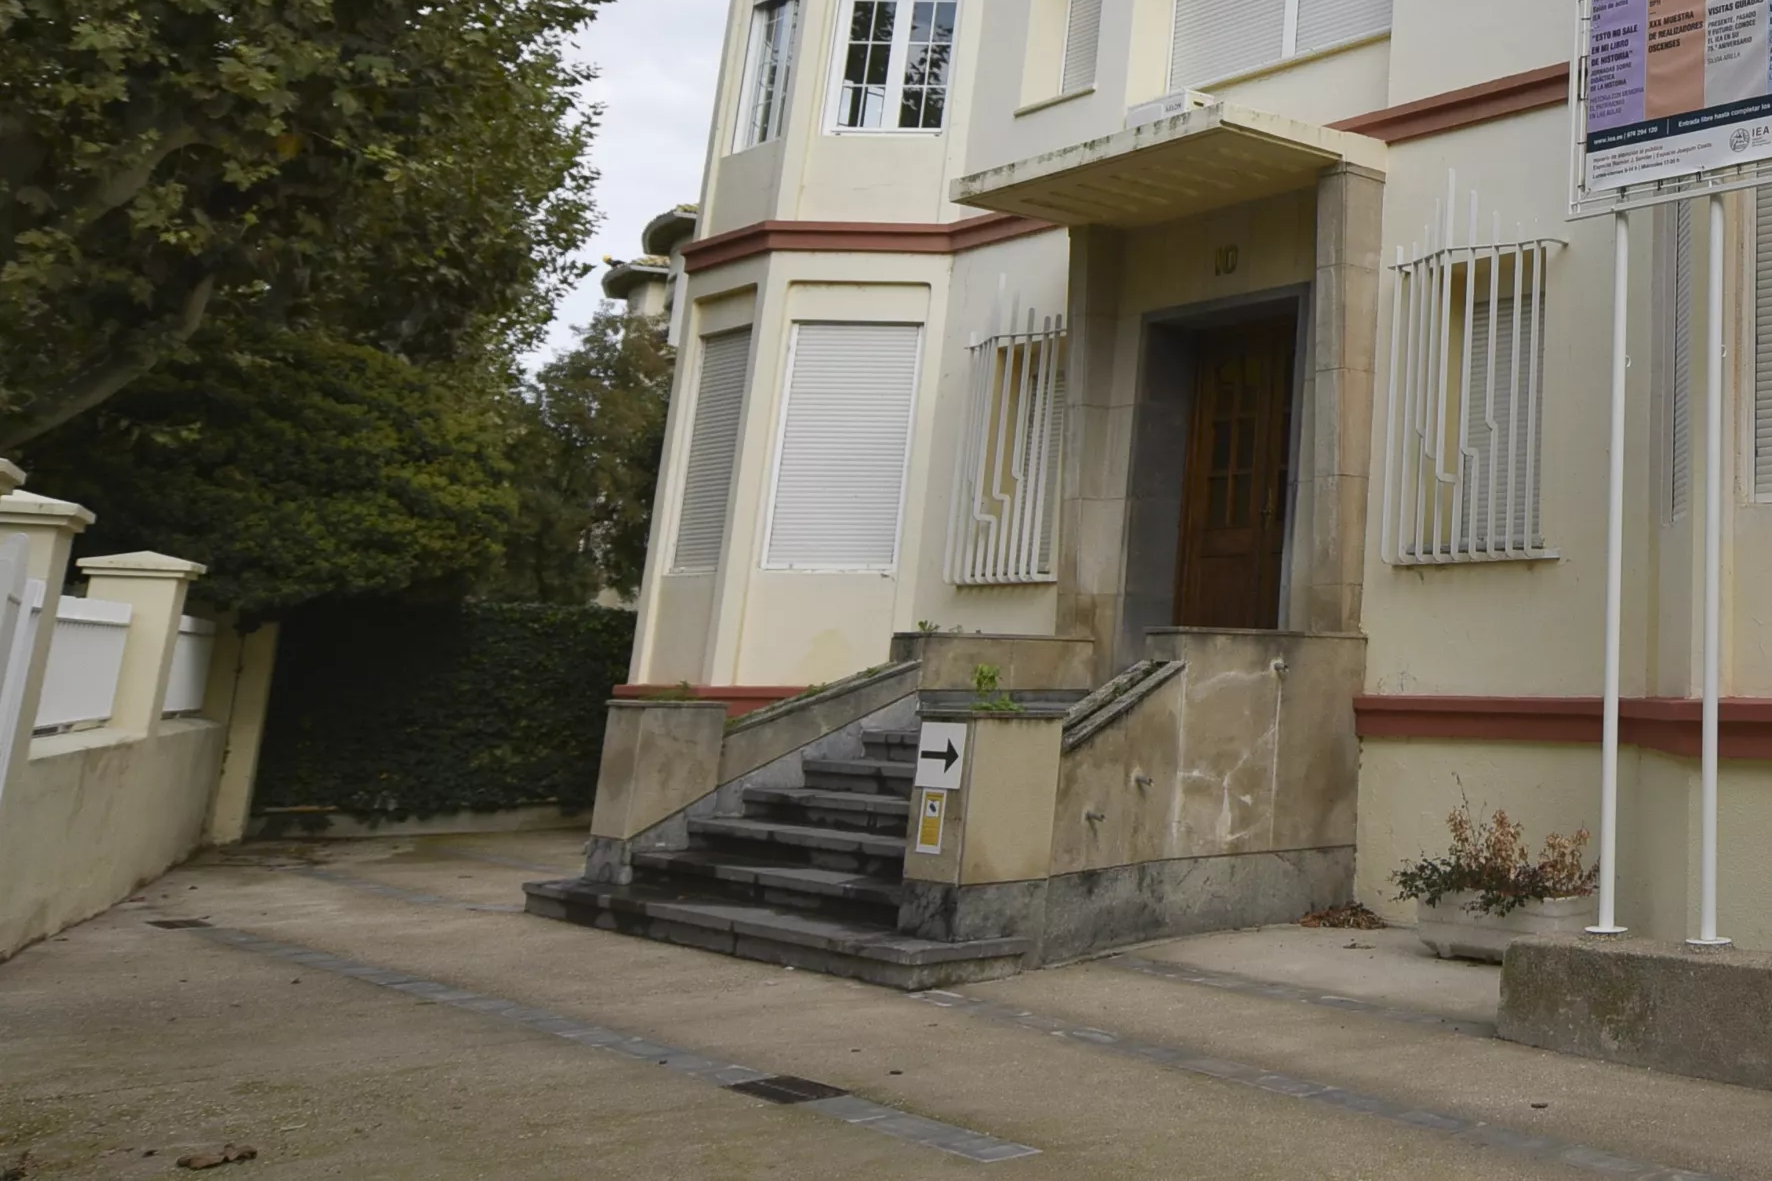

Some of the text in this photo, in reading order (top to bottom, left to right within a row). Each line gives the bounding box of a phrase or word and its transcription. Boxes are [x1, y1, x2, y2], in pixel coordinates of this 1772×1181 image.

[1708, 3, 1733, 15] VISITAS
[1664, 11, 1694, 24] MUESTRA
[1736, 11, 1756, 20] PASADO
[1735, 19, 1755, 29] CONOCE
[1613, 29, 1621, 37] NO
[1622, 25, 1637, 35] SALE
[1649, 21, 1703, 41] DE REALIZADORES
[1732, 31, 1739, 39] SU
[1592, 39, 1628, 54] EN MI LIBRO
[1648, 39, 1680, 53] OSCENSES
[1718, 37, 1752, 49] ANIVERSARIO
[1591, 58, 1598, 67] DE
[1678, 119, 1700, 127] Entrada
[1731, 106, 1760, 115] completar
[1752, 126, 1769, 137] IEA
